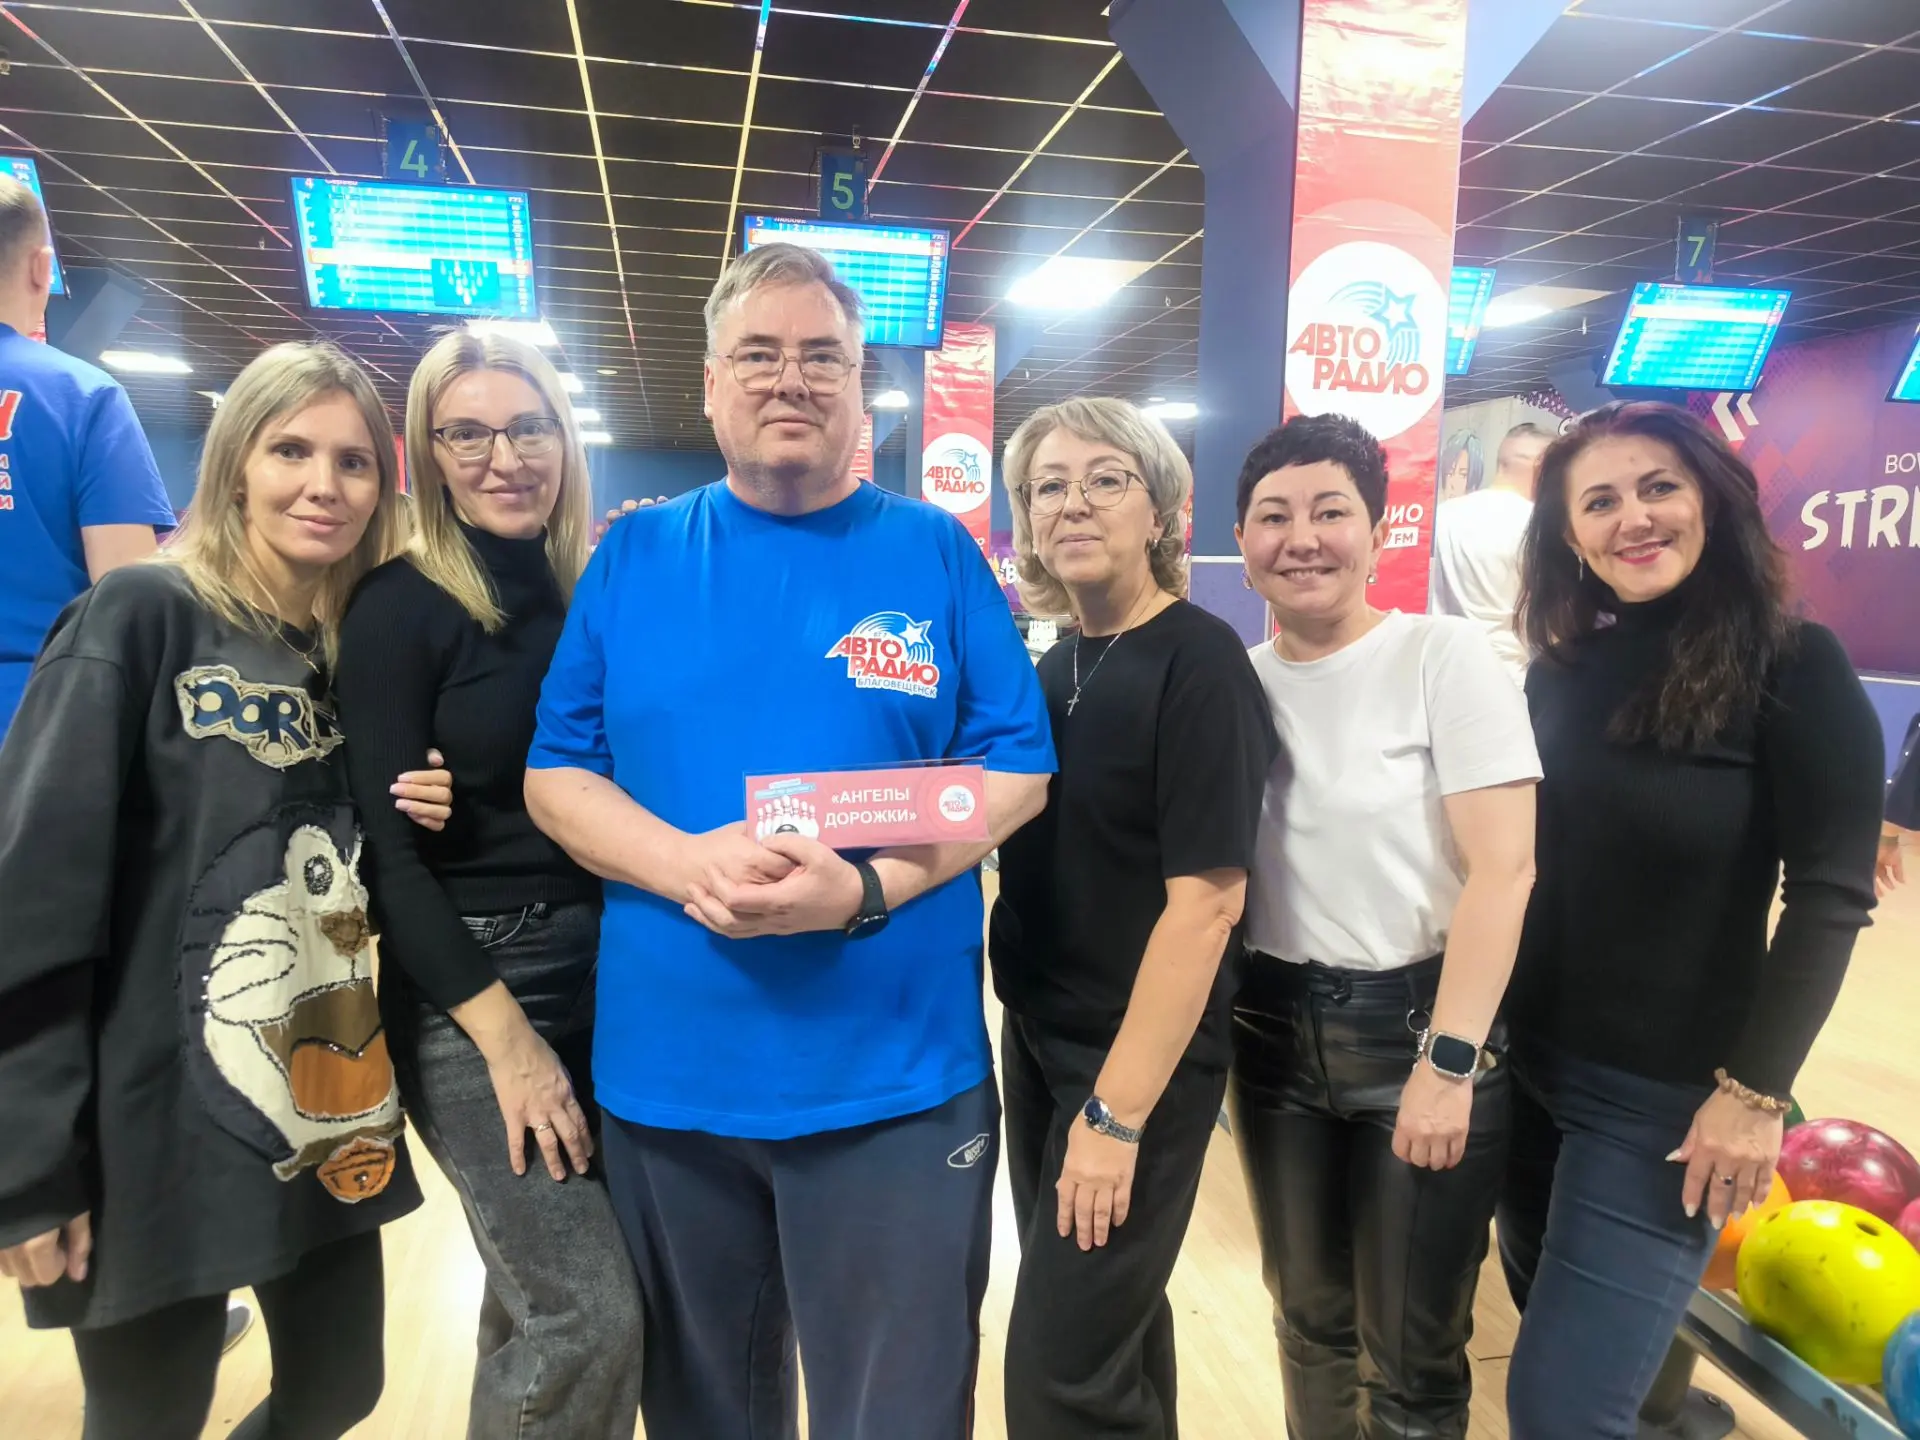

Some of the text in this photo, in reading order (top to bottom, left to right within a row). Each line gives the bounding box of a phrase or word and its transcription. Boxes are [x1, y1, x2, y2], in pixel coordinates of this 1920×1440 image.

[400, 139, 429, 178] 4
[831, 172, 854, 210] 5
[1687, 236, 1706, 267] 7
[1288, 322, 1381, 359] АВТО
[1312, 357, 1430, 396] РАДИО
[924, 465, 964, 480] АВТО
[935, 480, 985, 494] РАДИО
[1394, 532, 1414, 545] FM
[826, 636, 903, 659] АВТО
[849, 655, 938, 686] РАДИО
[857, 677, 937, 697] БЛАГОВЕЩЕНСК
[831, 787, 910, 804] «АНГЕЛЫ
[824, 808, 918, 829] ДОРОЖКИ»
